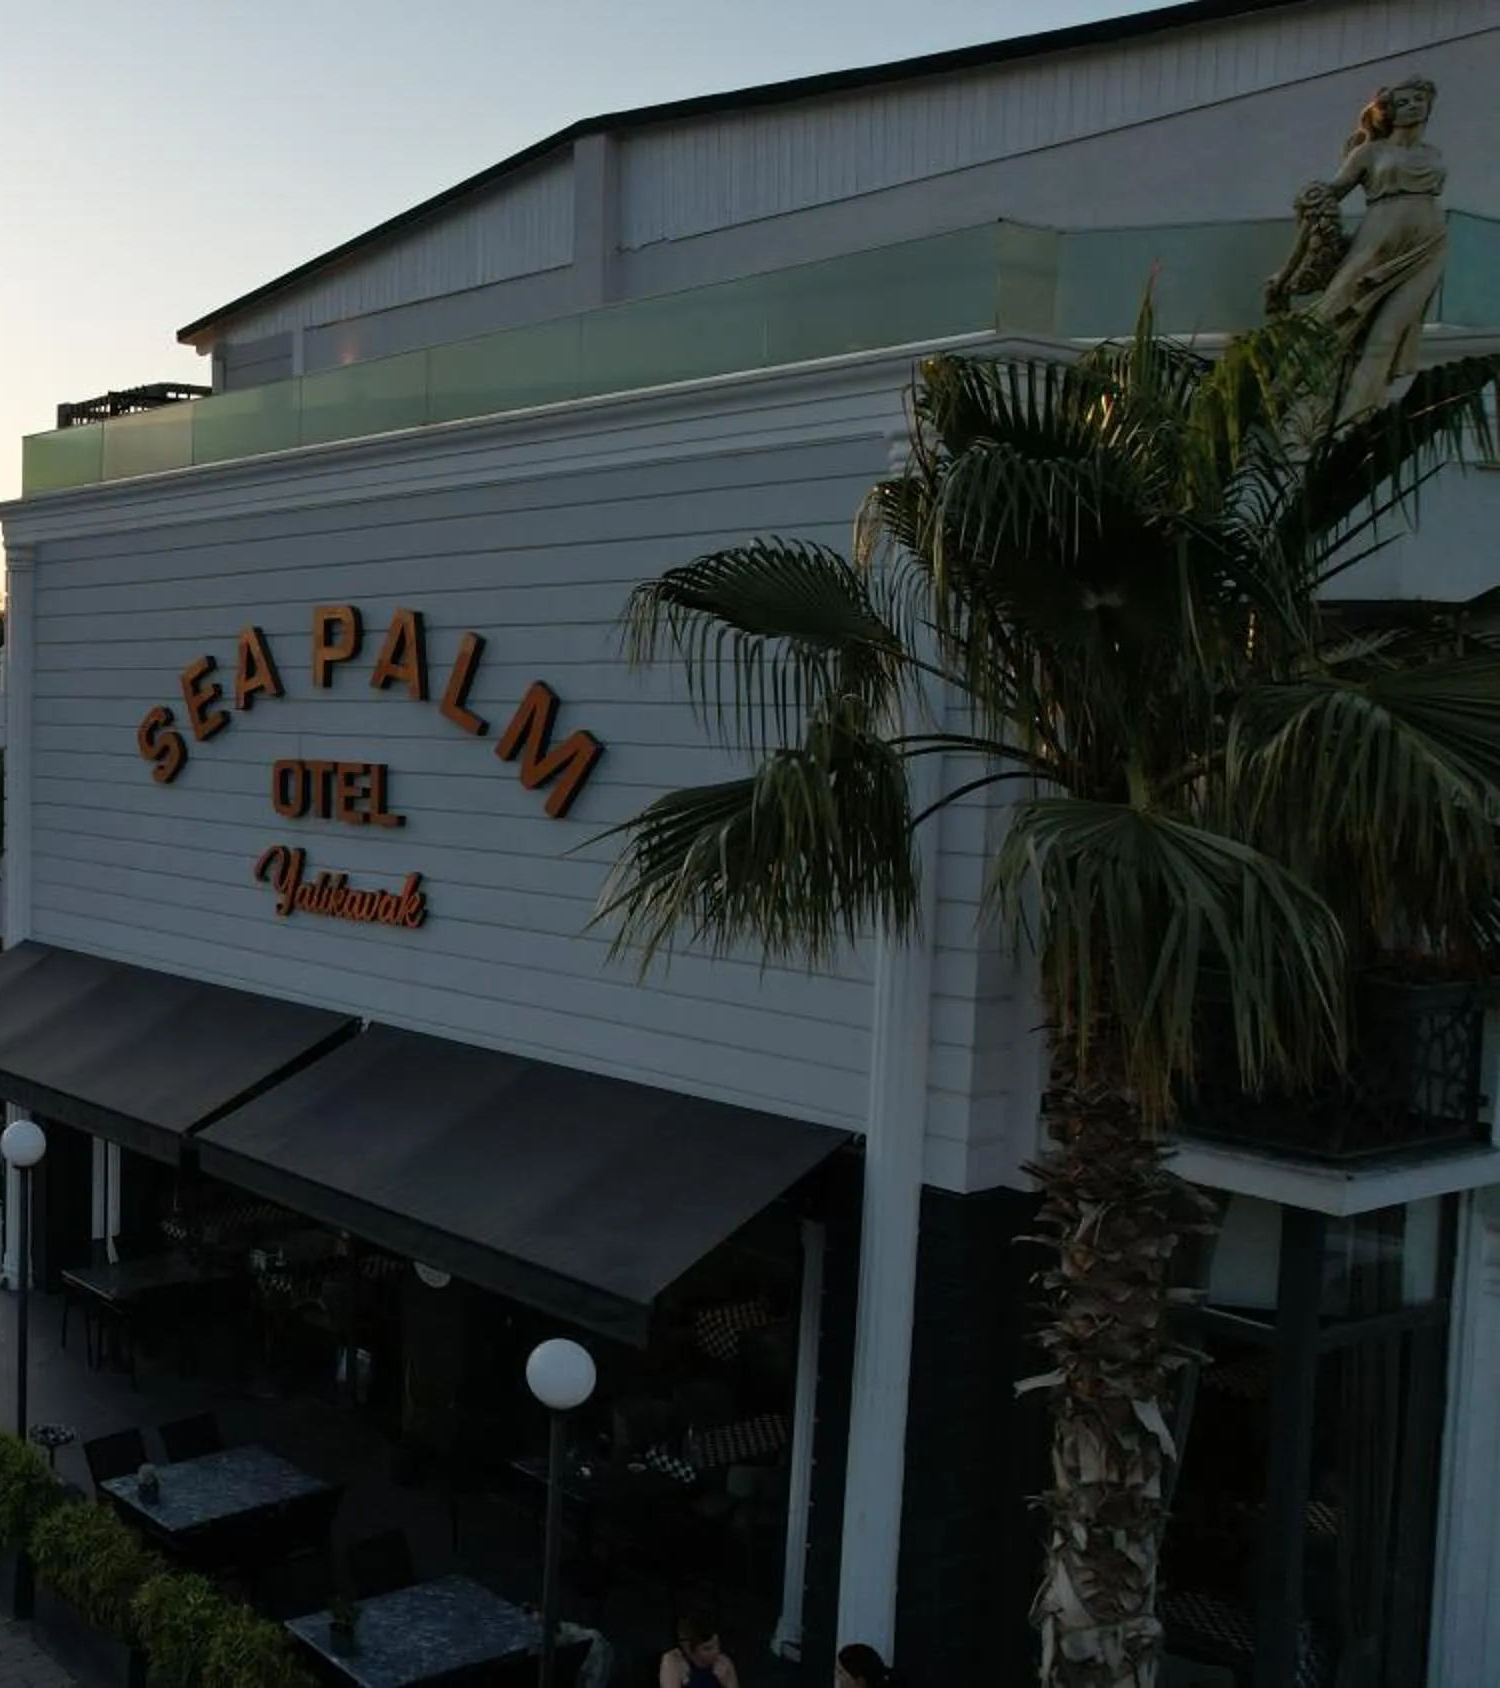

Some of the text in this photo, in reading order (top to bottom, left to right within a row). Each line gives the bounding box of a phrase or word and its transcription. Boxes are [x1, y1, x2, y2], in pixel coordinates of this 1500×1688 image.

[137, 604, 604, 819] SEA PALM
[271, 759, 407, 827] OTEL
